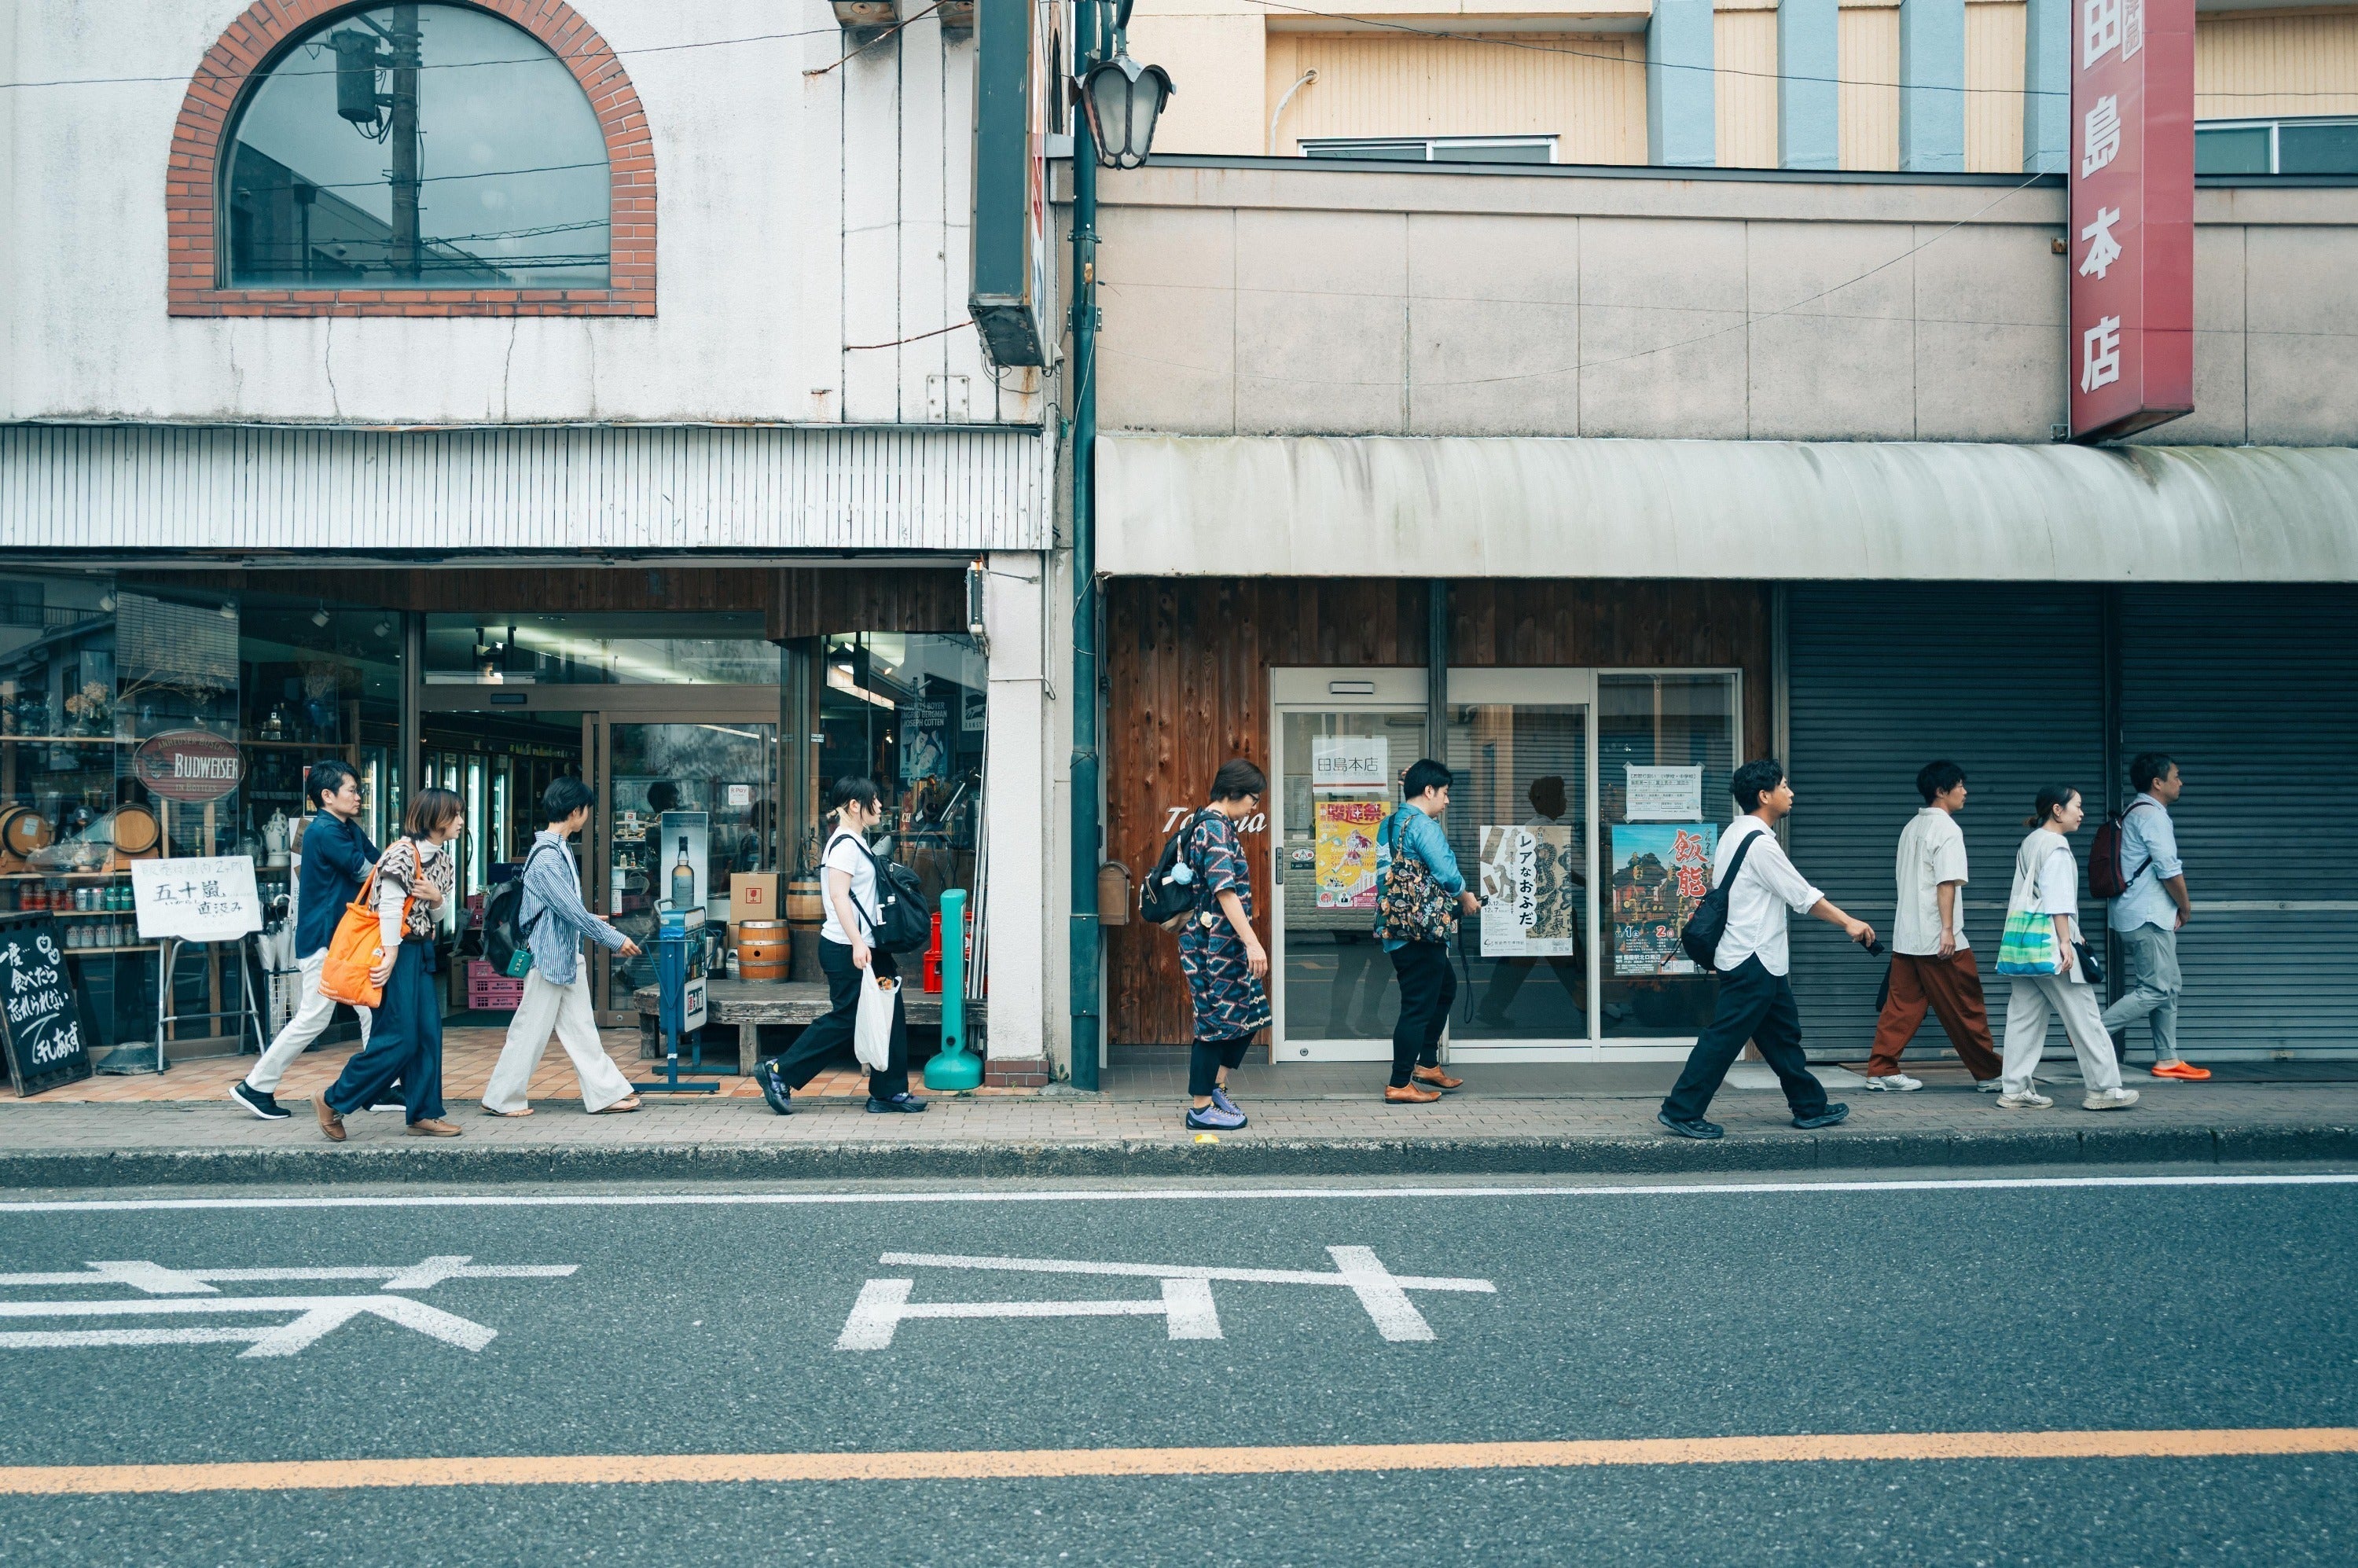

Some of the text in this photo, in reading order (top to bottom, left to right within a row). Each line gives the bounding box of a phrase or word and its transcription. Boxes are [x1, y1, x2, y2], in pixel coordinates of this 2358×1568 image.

[2079, 0, 2122, 394] 田島本店
[921, 710, 948, 718] BERGMAN
[927, 701, 945, 710] BOYER
[904, 718, 924, 727] JOSEPH
[174, 753, 238, 779] BUDWEISER
[1318, 757, 1379, 772] 田島本店
[153, 880, 226, 902] 五十嵐
[1519, 835, 1534, 926] レアなおふだ
[198, 901, 243, 915] 直汲み
[11, 964, 58, 994] 食べたら
[7, 988, 69, 1023] 忘れられない
